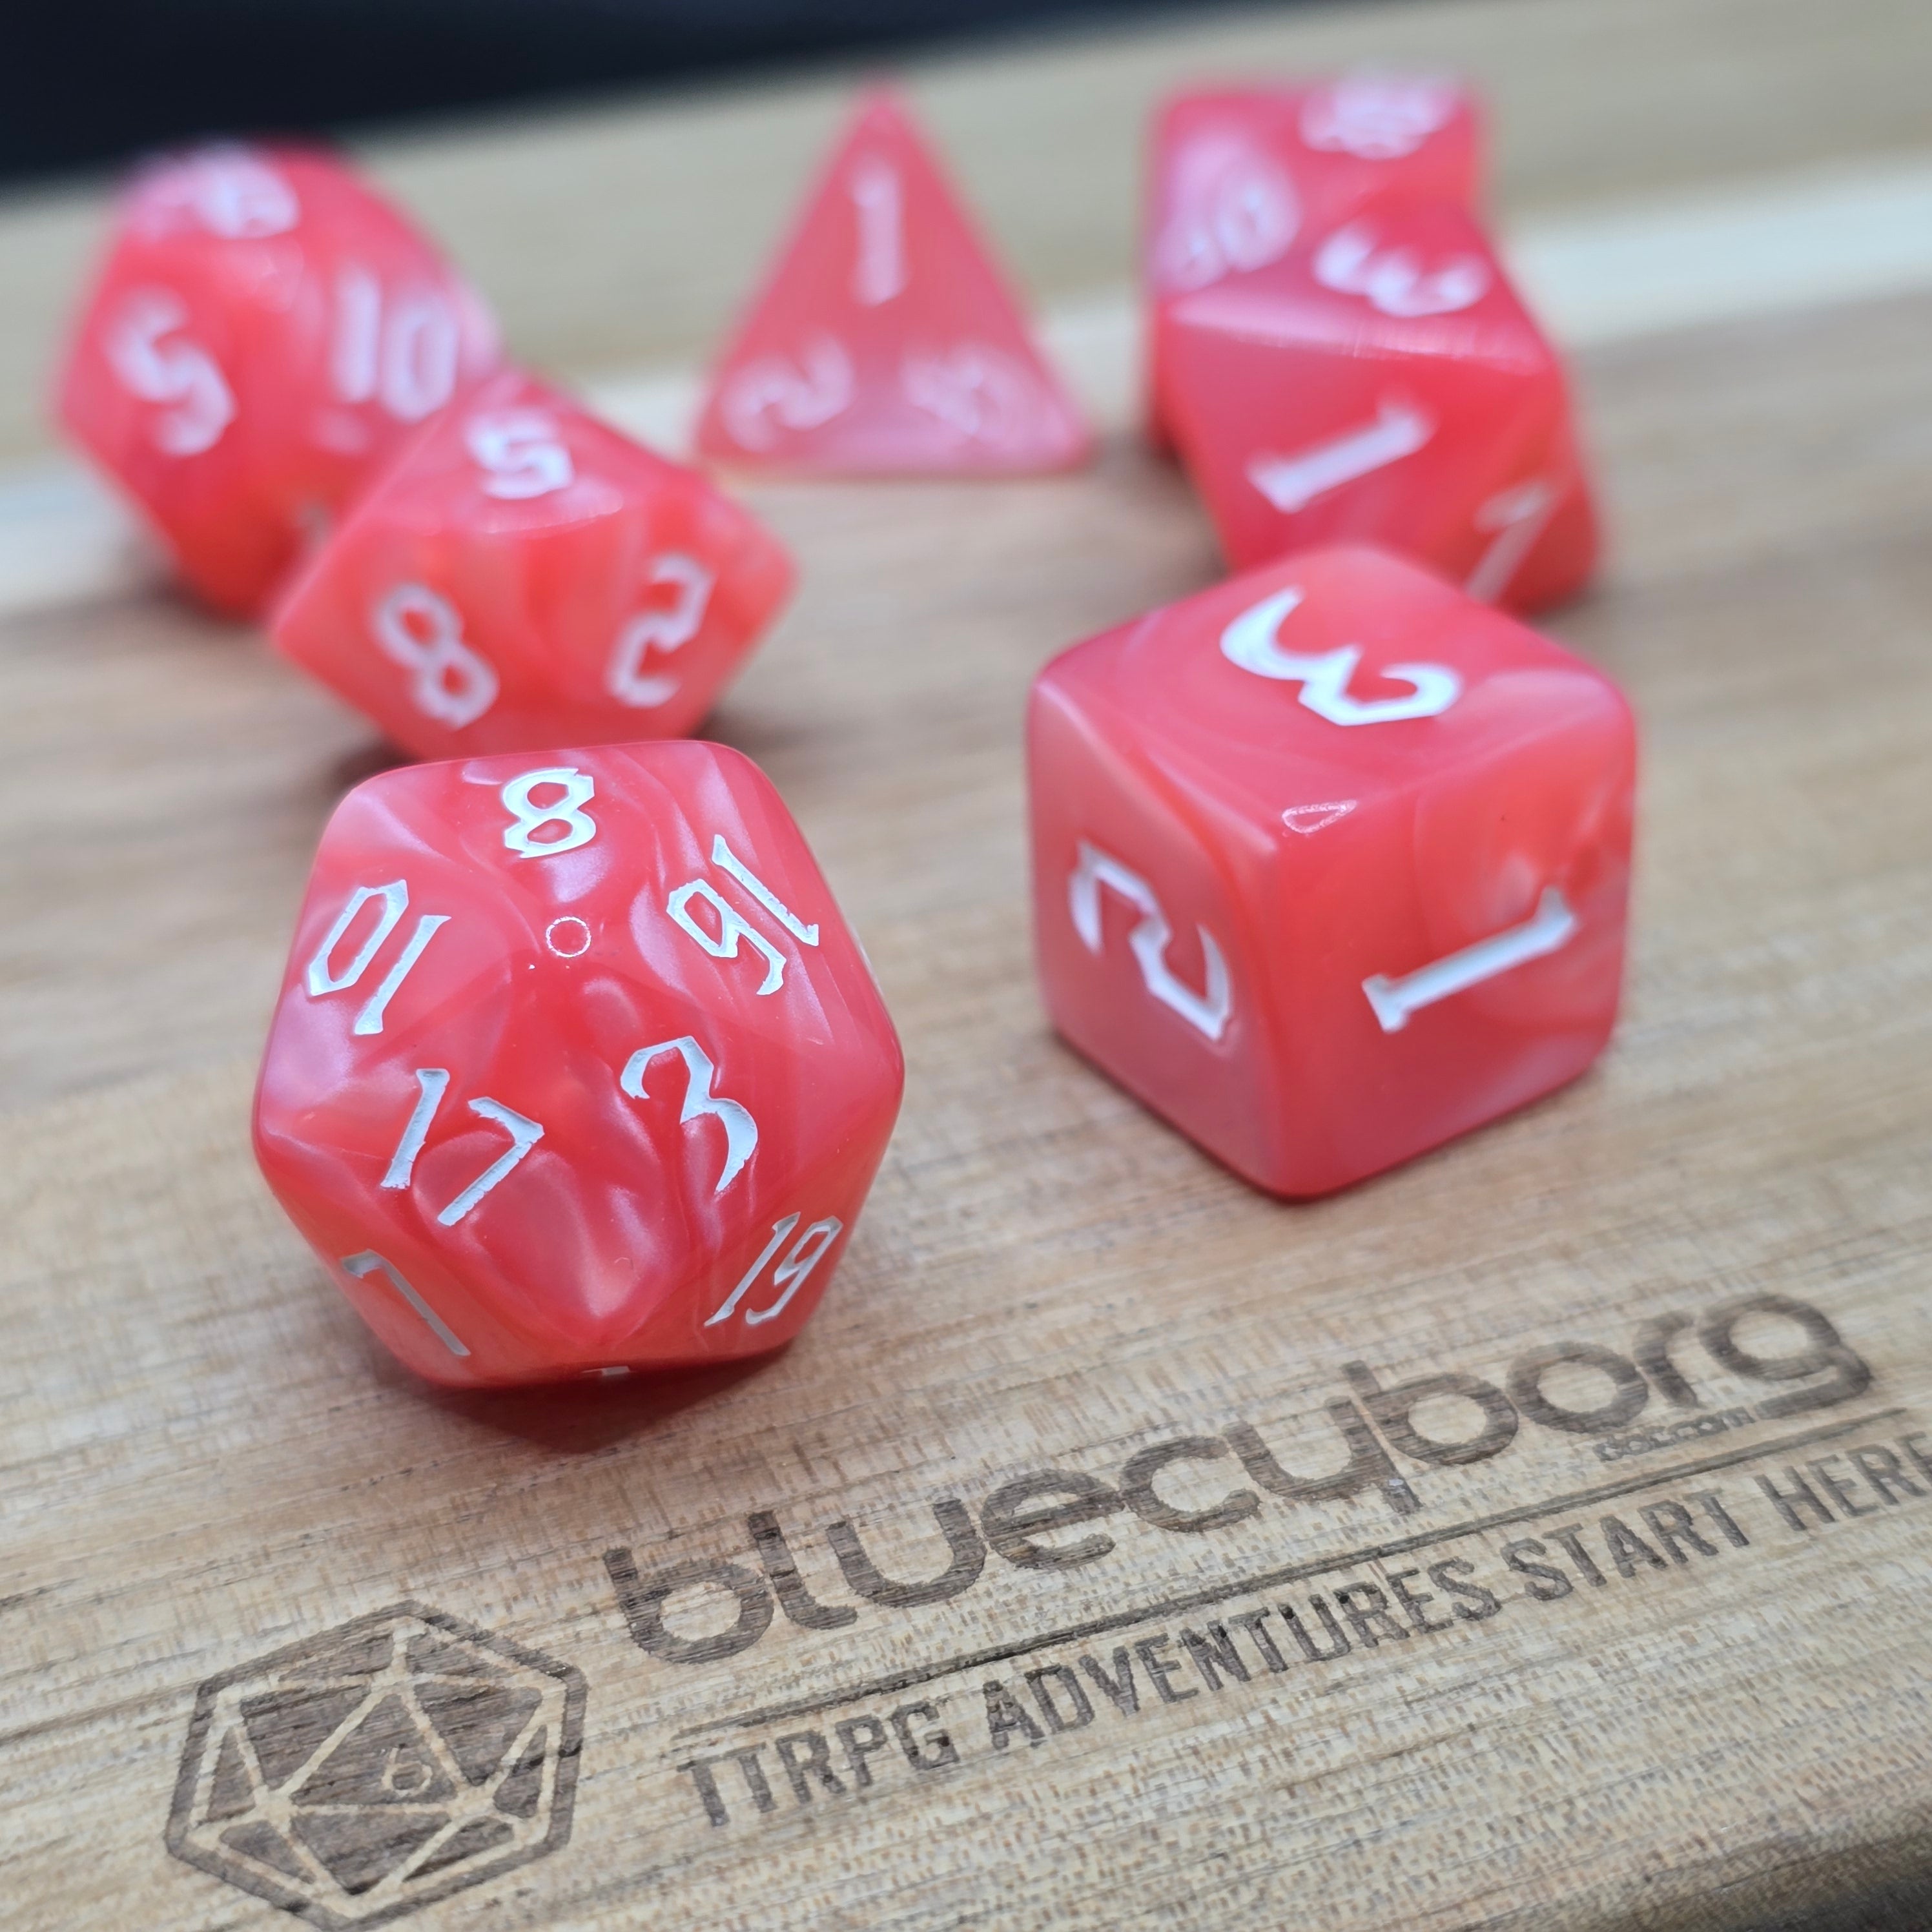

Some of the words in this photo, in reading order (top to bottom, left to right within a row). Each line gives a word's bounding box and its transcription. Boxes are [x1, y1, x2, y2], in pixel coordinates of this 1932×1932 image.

[850, 156, 907, 307] 1
[1312, 220, 1492, 317] 3
[103, 283, 236, 457] 5
[332, 265, 457, 422] 10
[721, 331, 856, 453] 2
[461, 408, 575, 500] 5
[1246, 395, 1434, 513] 1
[372, 581, 500, 731] 8
[607, 552, 715, 709] 2
[1219, 584, 1464, 727] 3
[501, 767, 597, 859] 8
[307, 879, 452, 1035] 10
[666, 834, 820, 996] 16
[1067, 839, 1232, 1042] 2
[1360, 883, 1577, 1034] 1
[380, 1067, 546, 1227] 17
[619, 1034, 759, 1193] 3
[703, 1211, 845, 1326] 19
[602, 1294, 1873, 1665] bluecyborg
[676, 1700, 961, 1828] TTRPG
[982, 1556, 1503, 1749] ADVENTURES
[1499, 1487, 1751, 1601] START
[1752, 1430, 1932, 1532] HERE
